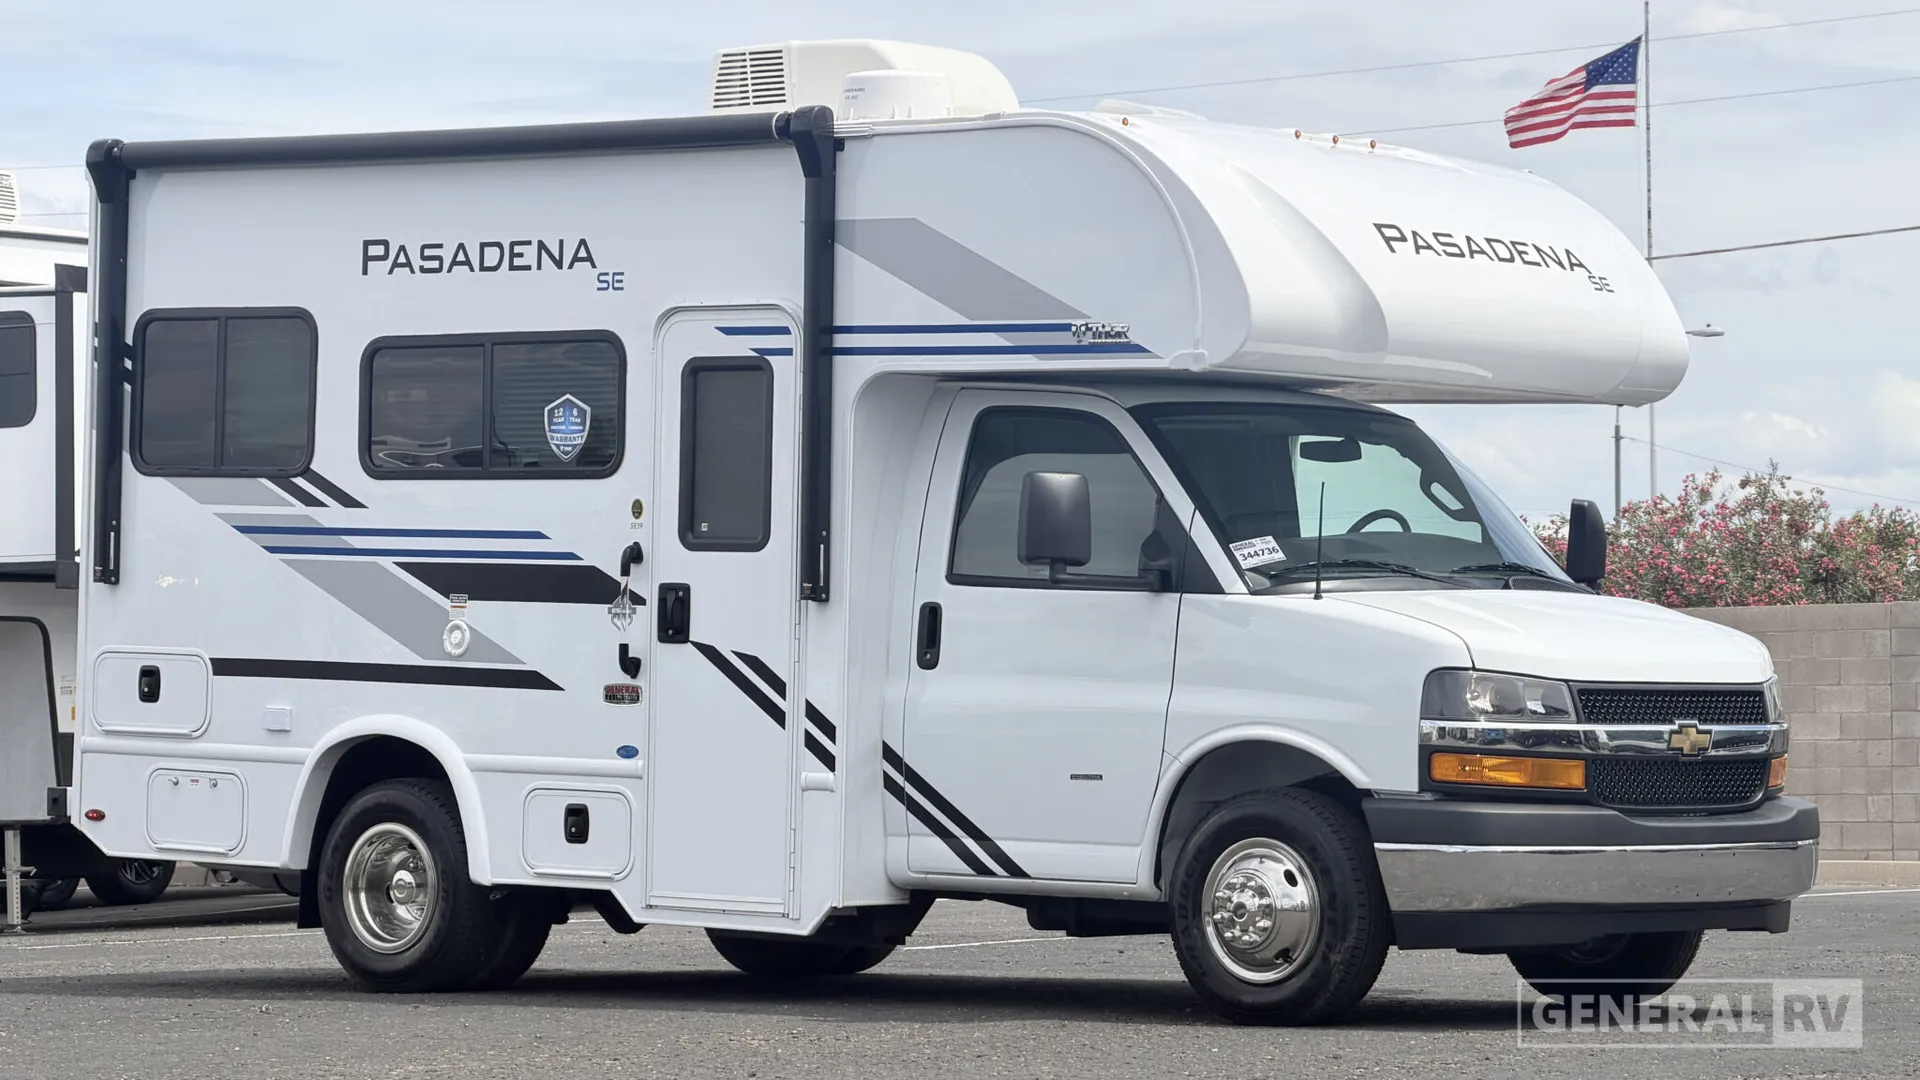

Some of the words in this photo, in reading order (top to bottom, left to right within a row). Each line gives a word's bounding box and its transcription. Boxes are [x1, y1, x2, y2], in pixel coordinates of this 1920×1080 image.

[362, 238, 597, 276] PASADENA
[1372, 223, 1592, 275] PASADENA
[596, 272, 625, 291] SE
[1588, 275, 1615, 293] SE
[1088, 323, 1130, 340] THOR
[554, 408, 563, 416] 12
[573, 408, 578, 416] 6
[550, 435, 583, 443] WARRANTY
[1239, 546, 1280, 561] 344736
[607, 685, 640, 695] GENERAL
